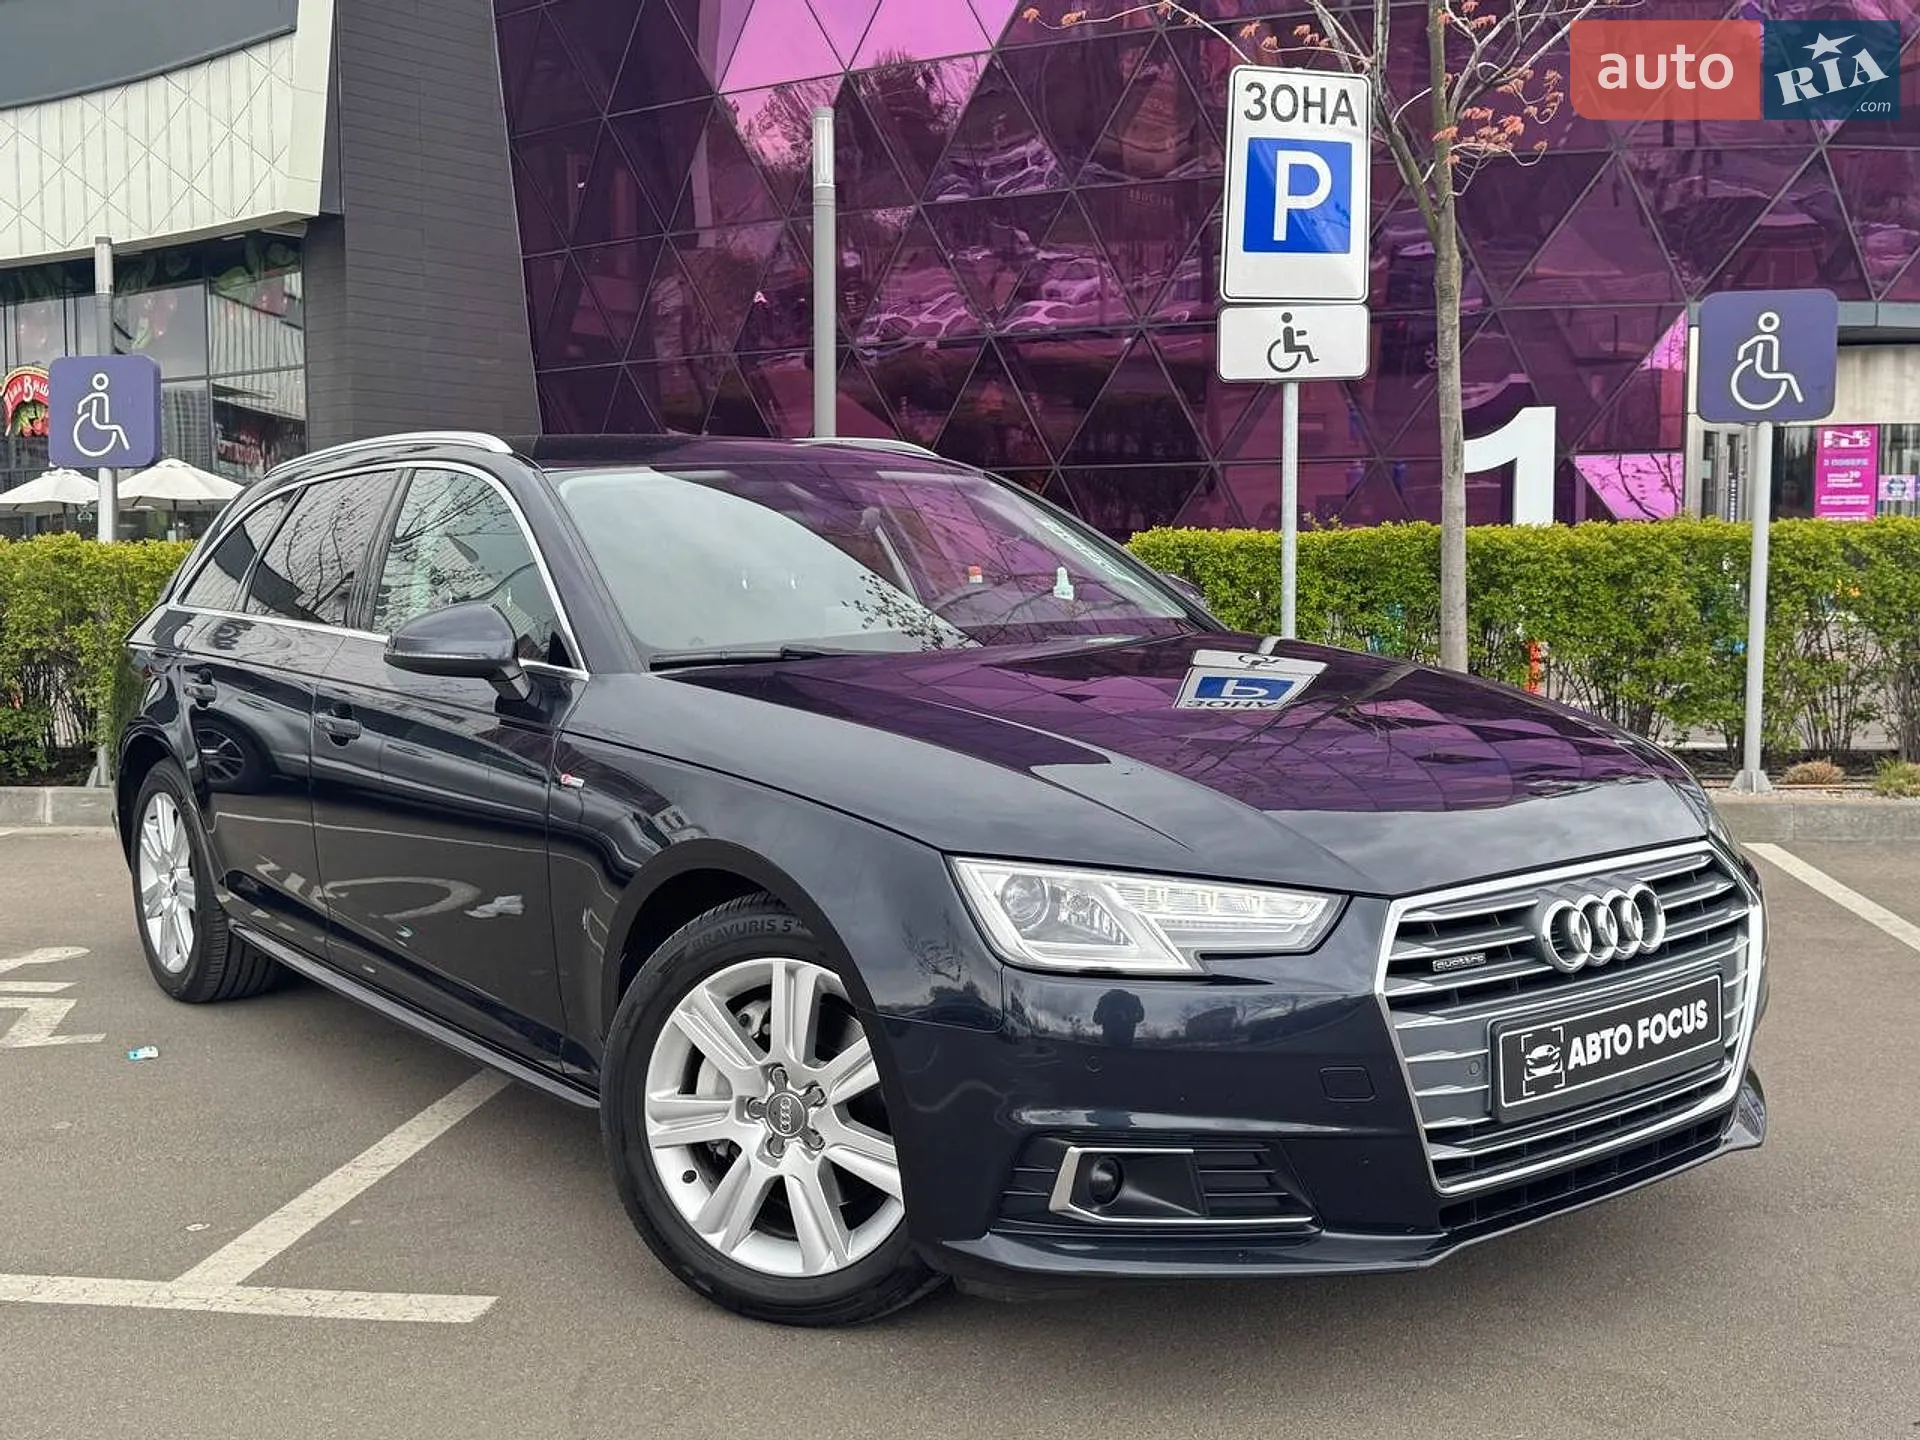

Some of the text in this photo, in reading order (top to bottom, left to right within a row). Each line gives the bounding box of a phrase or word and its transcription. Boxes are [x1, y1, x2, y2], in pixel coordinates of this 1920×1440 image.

[1243, 82, 1358, 126] ЗОНА
[1273, 150, 1332, 241] P
[1463, 406, 1556, 527] 1
[1568, 999, 1708, 1070] АВТО FOCUS
